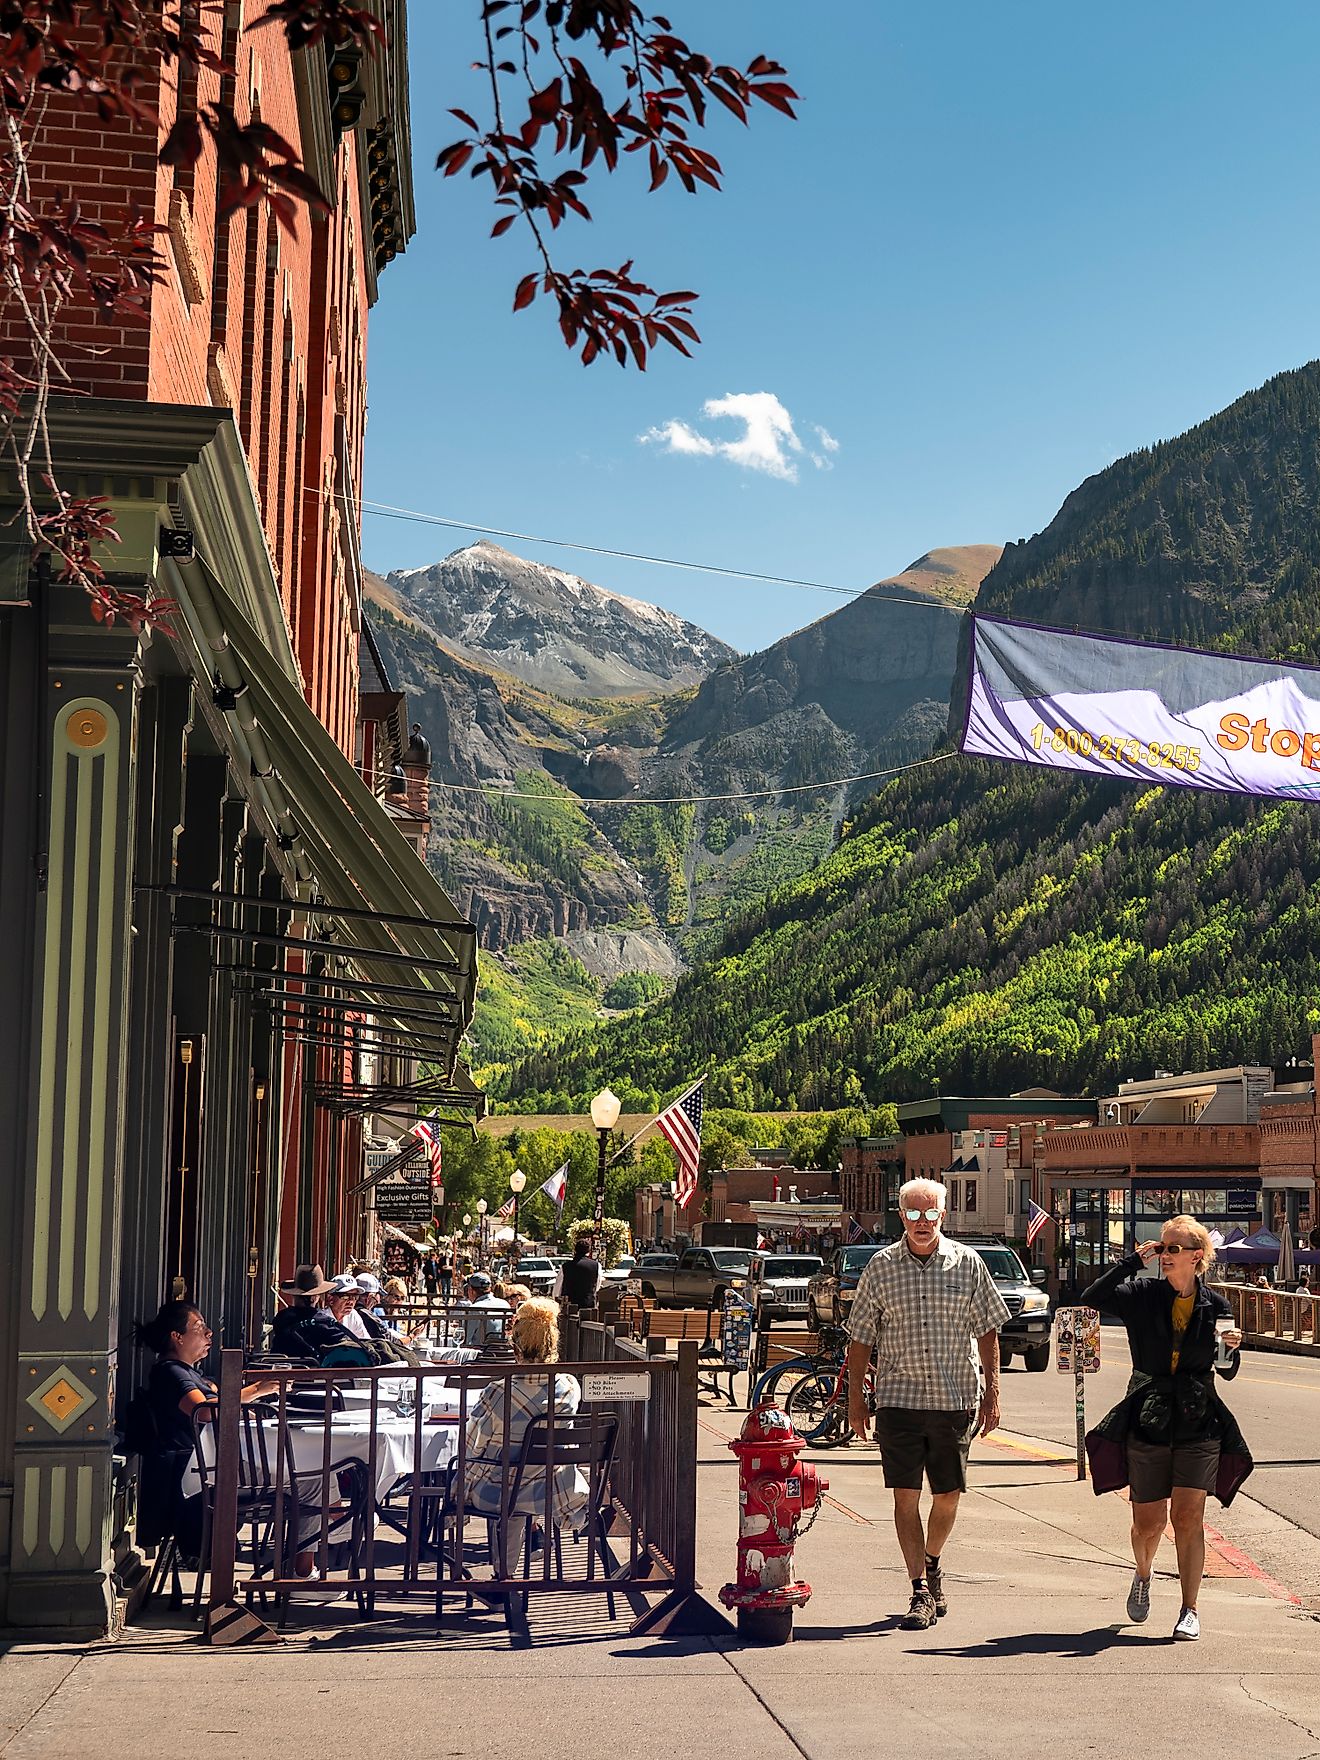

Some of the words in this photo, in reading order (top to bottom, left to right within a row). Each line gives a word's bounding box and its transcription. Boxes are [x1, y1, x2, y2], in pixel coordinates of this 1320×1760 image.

[1031, 722, 1201, 772] 1-800-273-8255
[402, 1169, 431, 1178] OUTSIDE
[411, 1193, 429, 1201] Gifts
